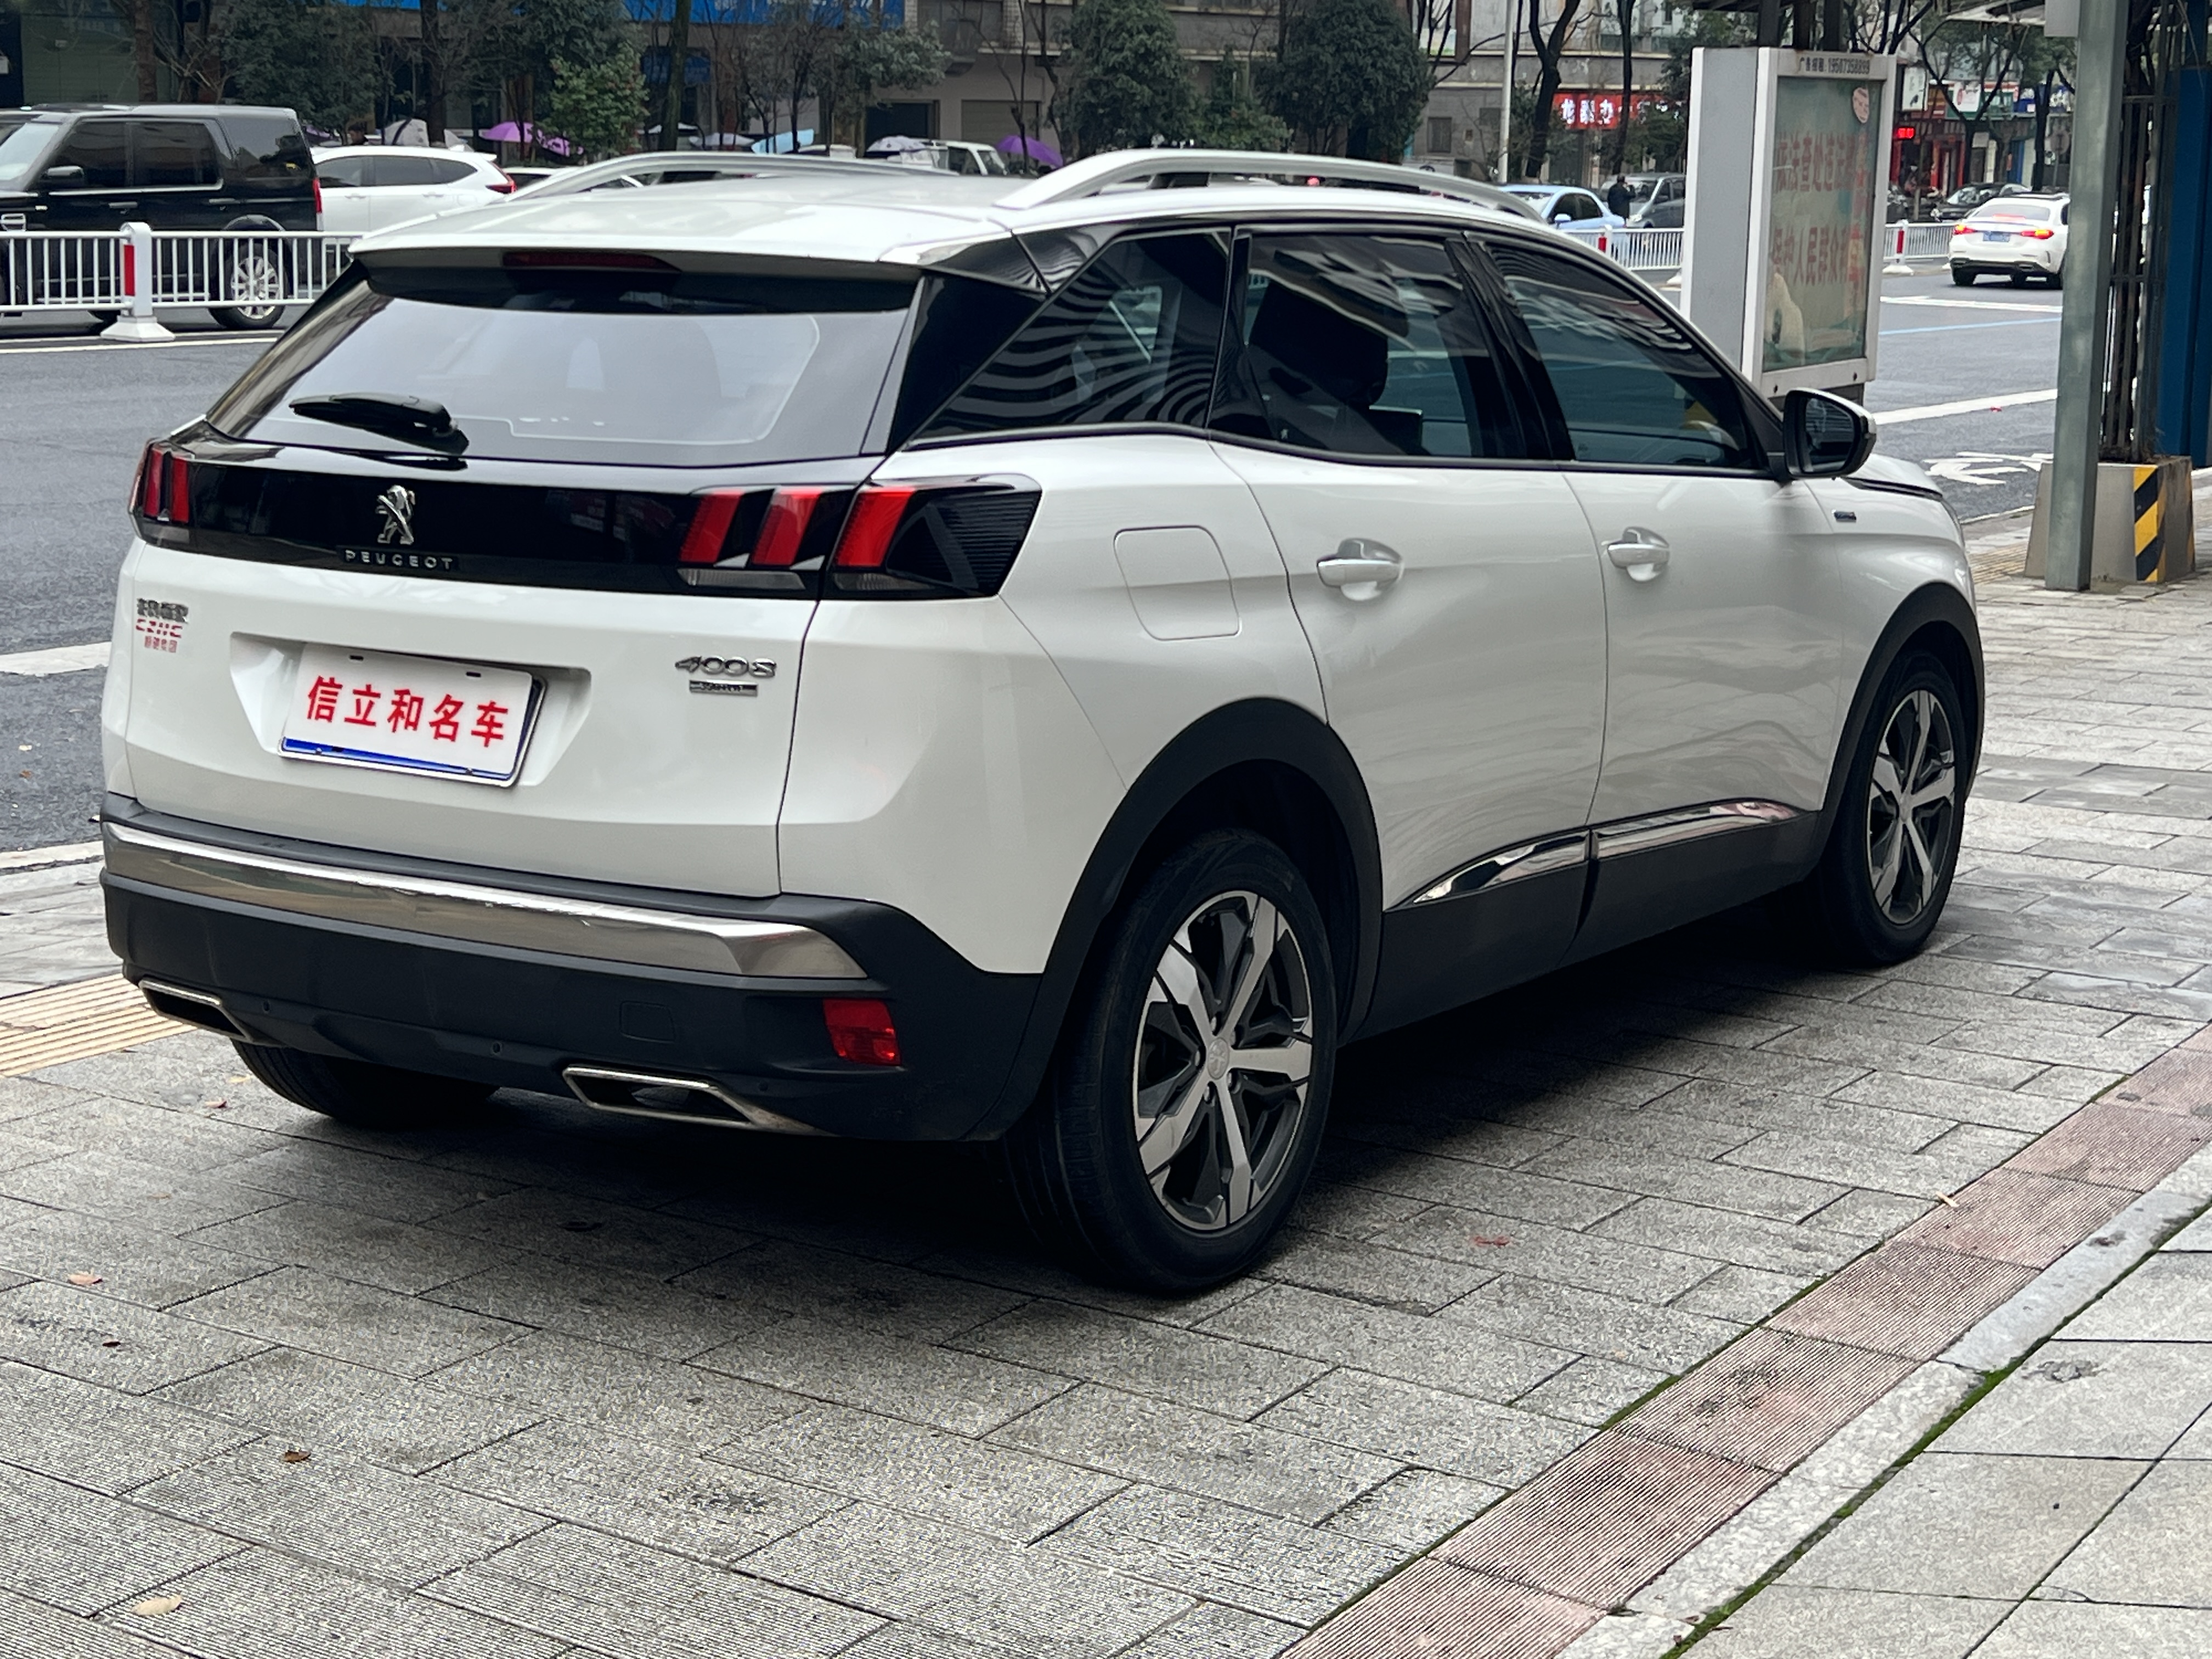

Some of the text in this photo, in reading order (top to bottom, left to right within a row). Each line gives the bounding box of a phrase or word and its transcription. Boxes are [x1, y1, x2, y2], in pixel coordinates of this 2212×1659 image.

[345, 549, 453, 569] PEUGEOT
[307, 675, 508, 748] 信立和名车
